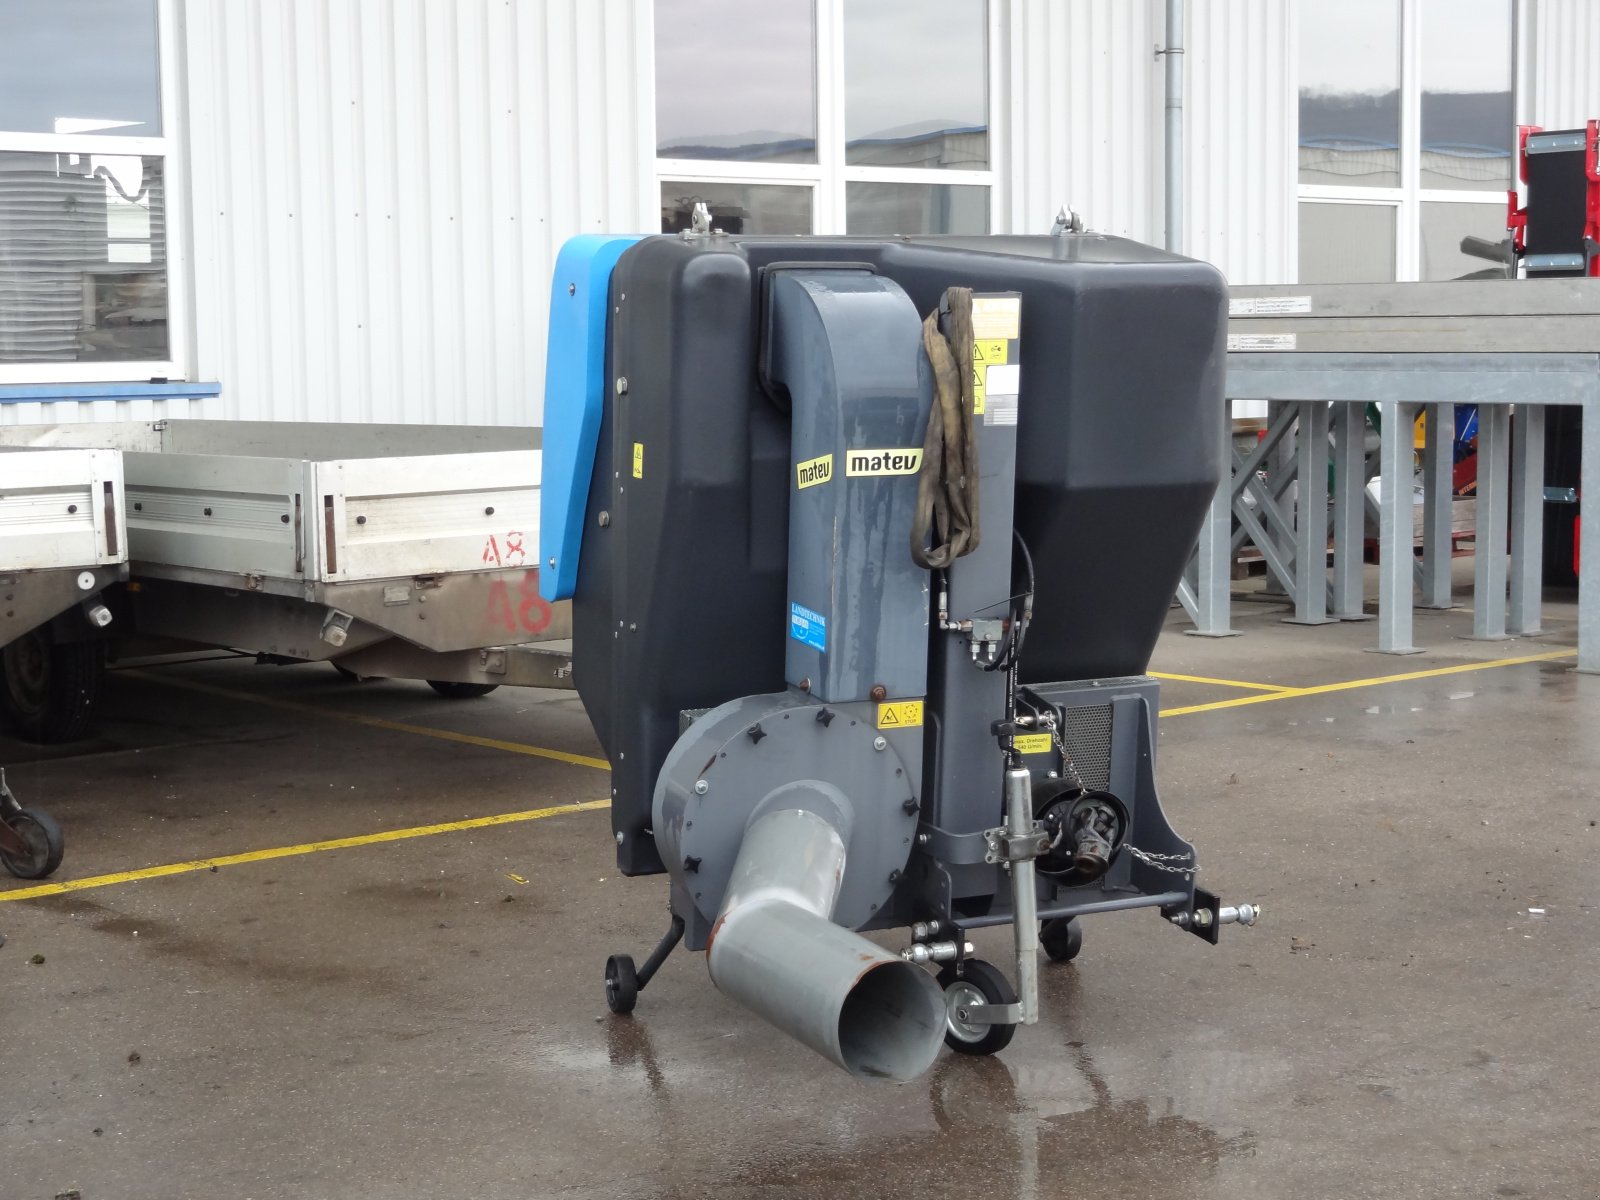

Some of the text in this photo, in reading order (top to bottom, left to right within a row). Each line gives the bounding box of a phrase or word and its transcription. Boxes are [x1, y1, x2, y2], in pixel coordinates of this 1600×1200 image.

[800, 461, 830, 484] matev
[851, 452, 917, 471] matev
[482, 530, 526, 569] A8
